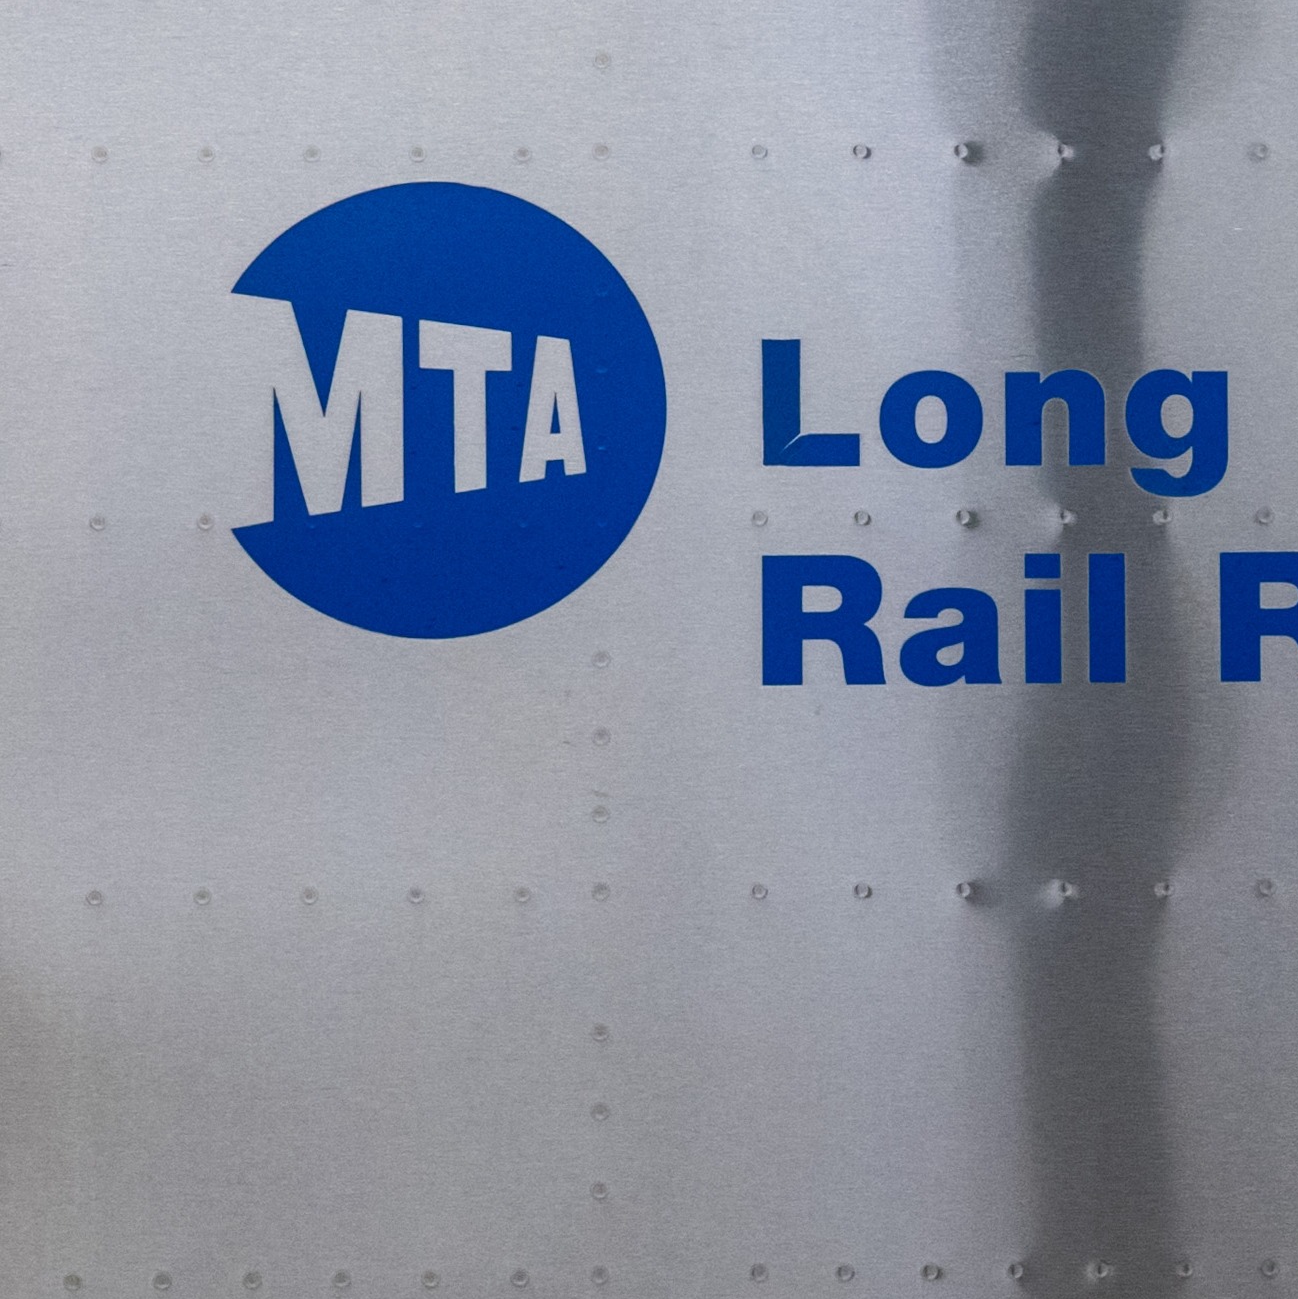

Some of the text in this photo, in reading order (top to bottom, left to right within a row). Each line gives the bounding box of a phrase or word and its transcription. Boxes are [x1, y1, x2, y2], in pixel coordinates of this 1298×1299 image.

[230, 292, 588, 530] MTA
[761, 338, 1229, 498] Long
[761, 552, 1127, 687] Rail
